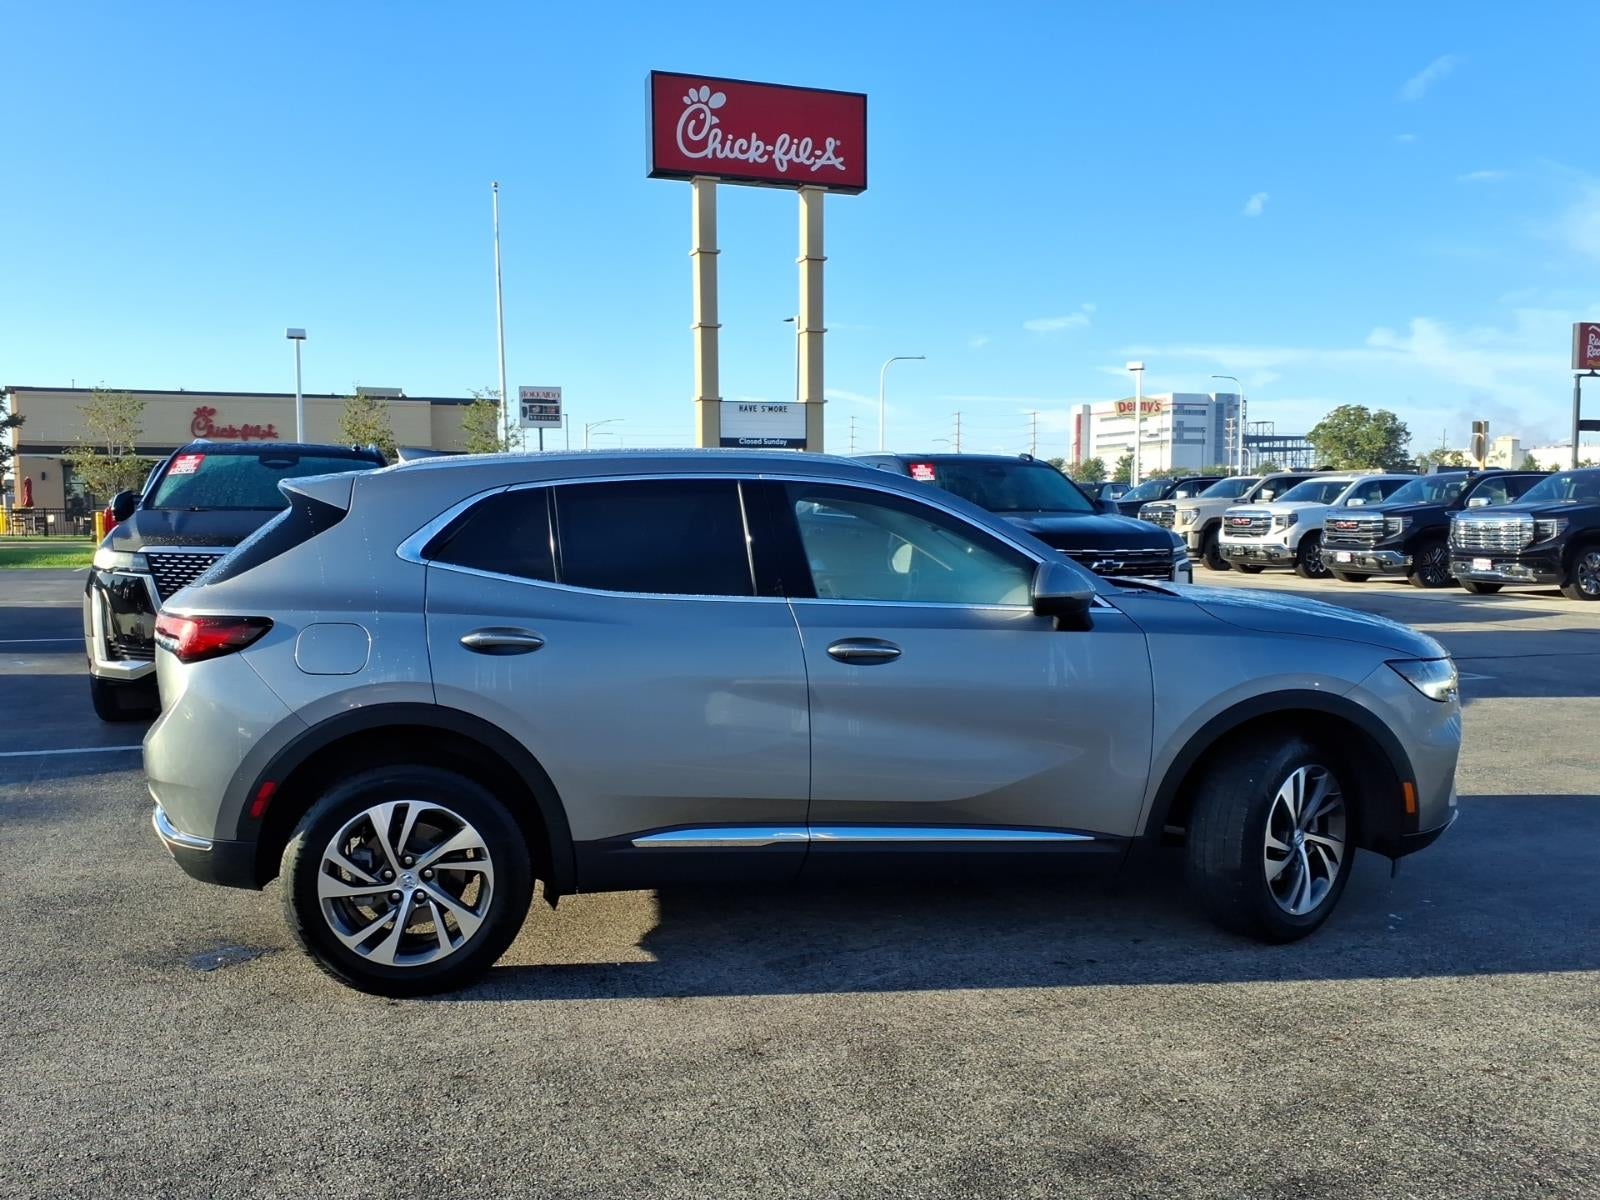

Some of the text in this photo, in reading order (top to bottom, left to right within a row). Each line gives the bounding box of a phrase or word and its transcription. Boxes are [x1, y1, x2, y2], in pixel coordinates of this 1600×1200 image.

[676, 101, 846, 173] Chick-fil-A
[1586, 344, 1600, 359] Roo
[739, 404, 788, 413] HAVE S'MORE
[191, 412, 279, 441] Chick-fil-A
[739, 437, 788, 447] Closed Sunday
